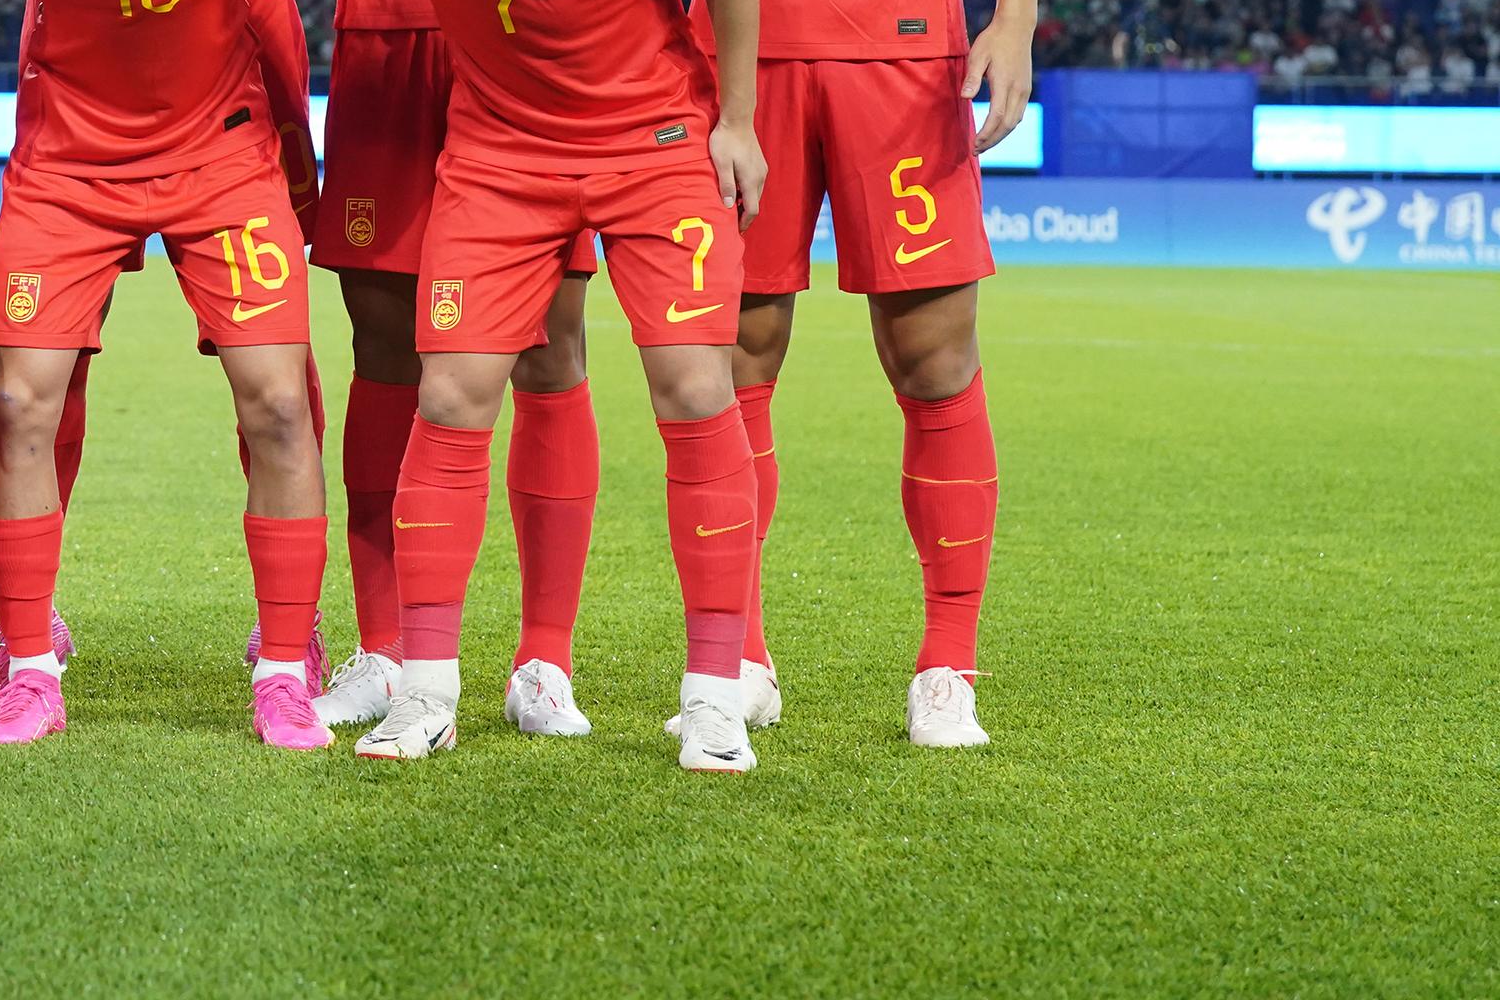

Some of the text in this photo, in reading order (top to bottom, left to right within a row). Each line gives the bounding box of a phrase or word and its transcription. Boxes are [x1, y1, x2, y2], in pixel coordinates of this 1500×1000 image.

[350, 202, 373, 210] CFA
[889, 156, 938, 235] 5
[1033, 205, 1118, 243] Cloud
[214, 216, 290, 296] 16
[671, 217, 714, 292] 7
[11, 277, 38, 287] CFA
[436, 284, 460, 293] CFA
